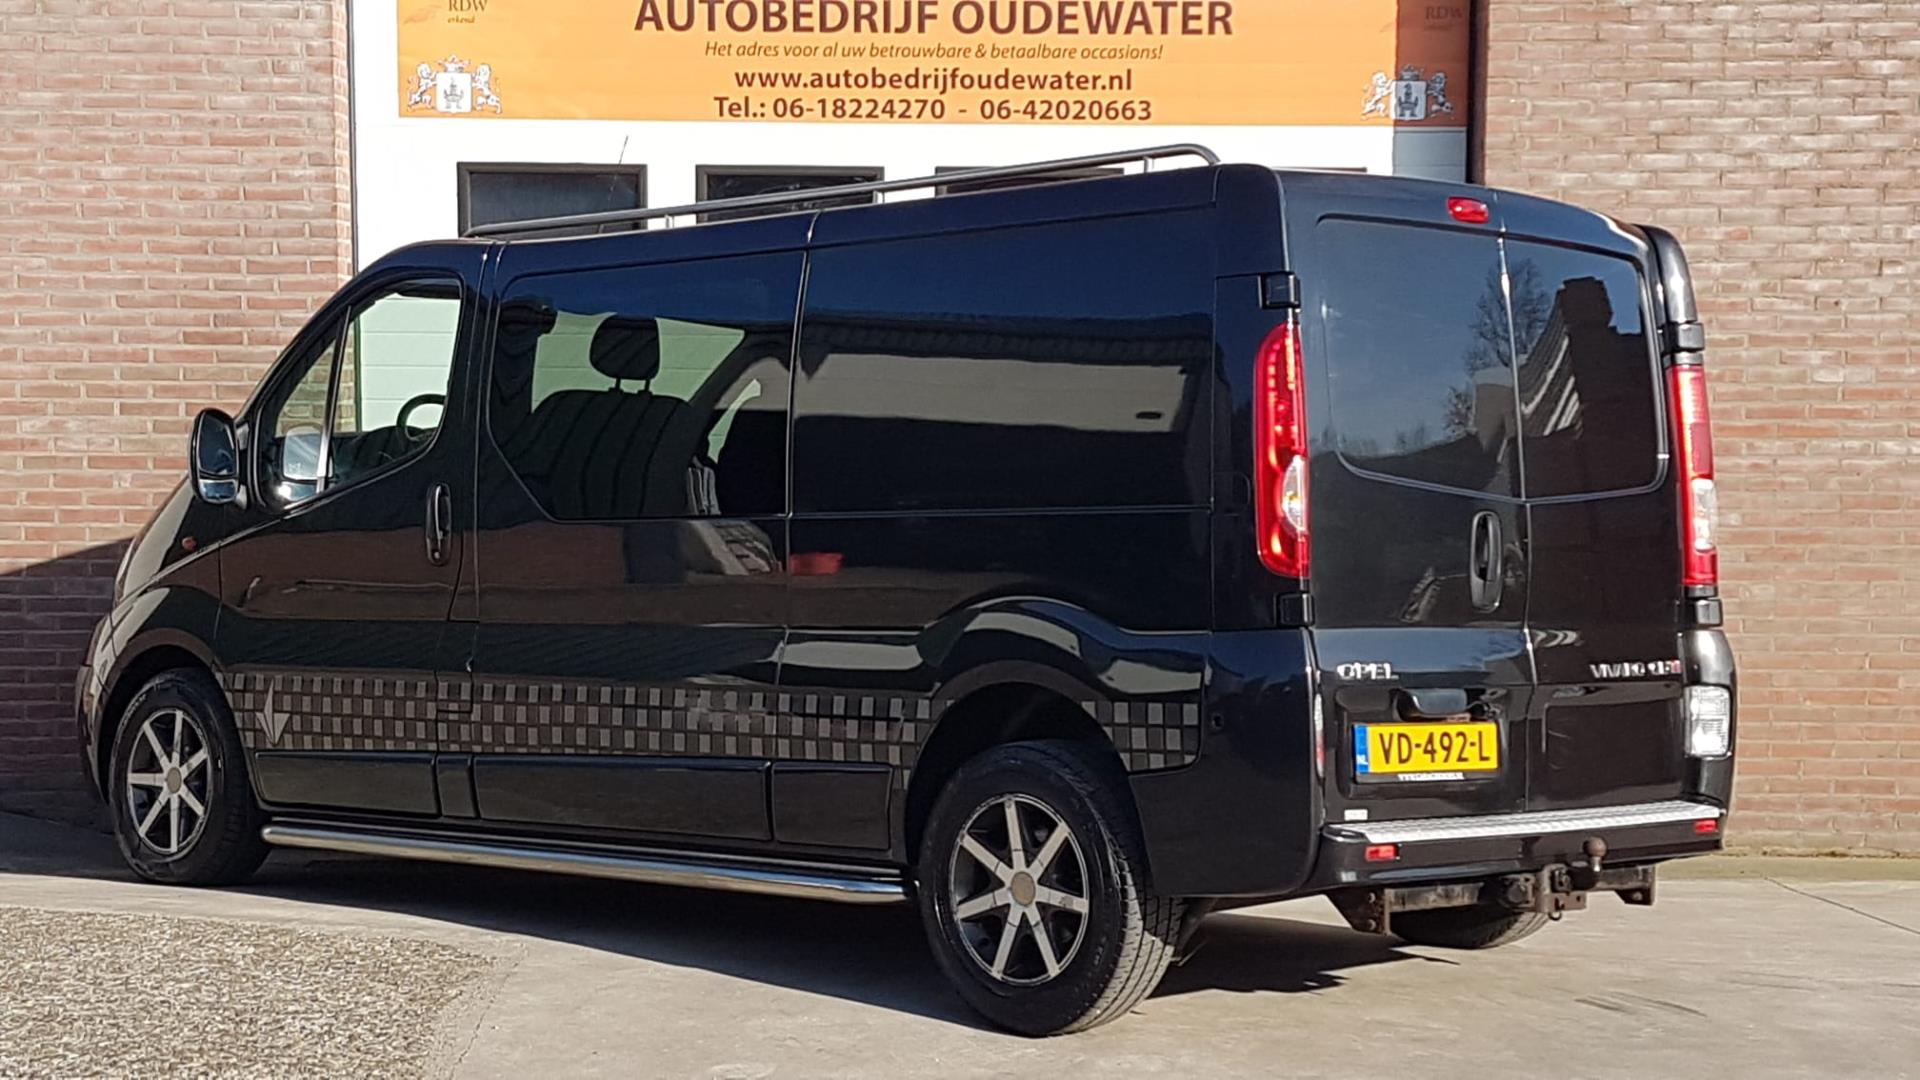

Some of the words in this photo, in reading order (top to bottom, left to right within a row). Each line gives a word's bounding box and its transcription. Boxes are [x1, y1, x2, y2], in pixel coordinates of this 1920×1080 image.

[448, 0, 488, 12] RDW
[634, 0, 939, 34] AUTOBEDRIJF
[952, 0, 1233, 35] OUDEWATER
[705, 41, 732, 57] Het
[736, 42, 780, 57] adres
[783, 46, 819, 58] voor
[822, 43, 838, 58] al
[842, 47, 866, 58] uw
[870, 43, 972, 59] betrouwbare
[975, 44, 987, 58] &
[990, 43, 1077, 60] betaalbare
[1080, 44, 1164, 60] occasions!
[734, 67, 1133, 95] www.autobedrijfoudewater.nl
[713, 96, 766, 118] Tel.:
[773, 98, 946, 119] 06-18224270
[980, 100, 1152, 121] 06-42020663
[1336, 662, 1399, 680] OPEL
[1379, 728, 1491, 765] VD-492-L
